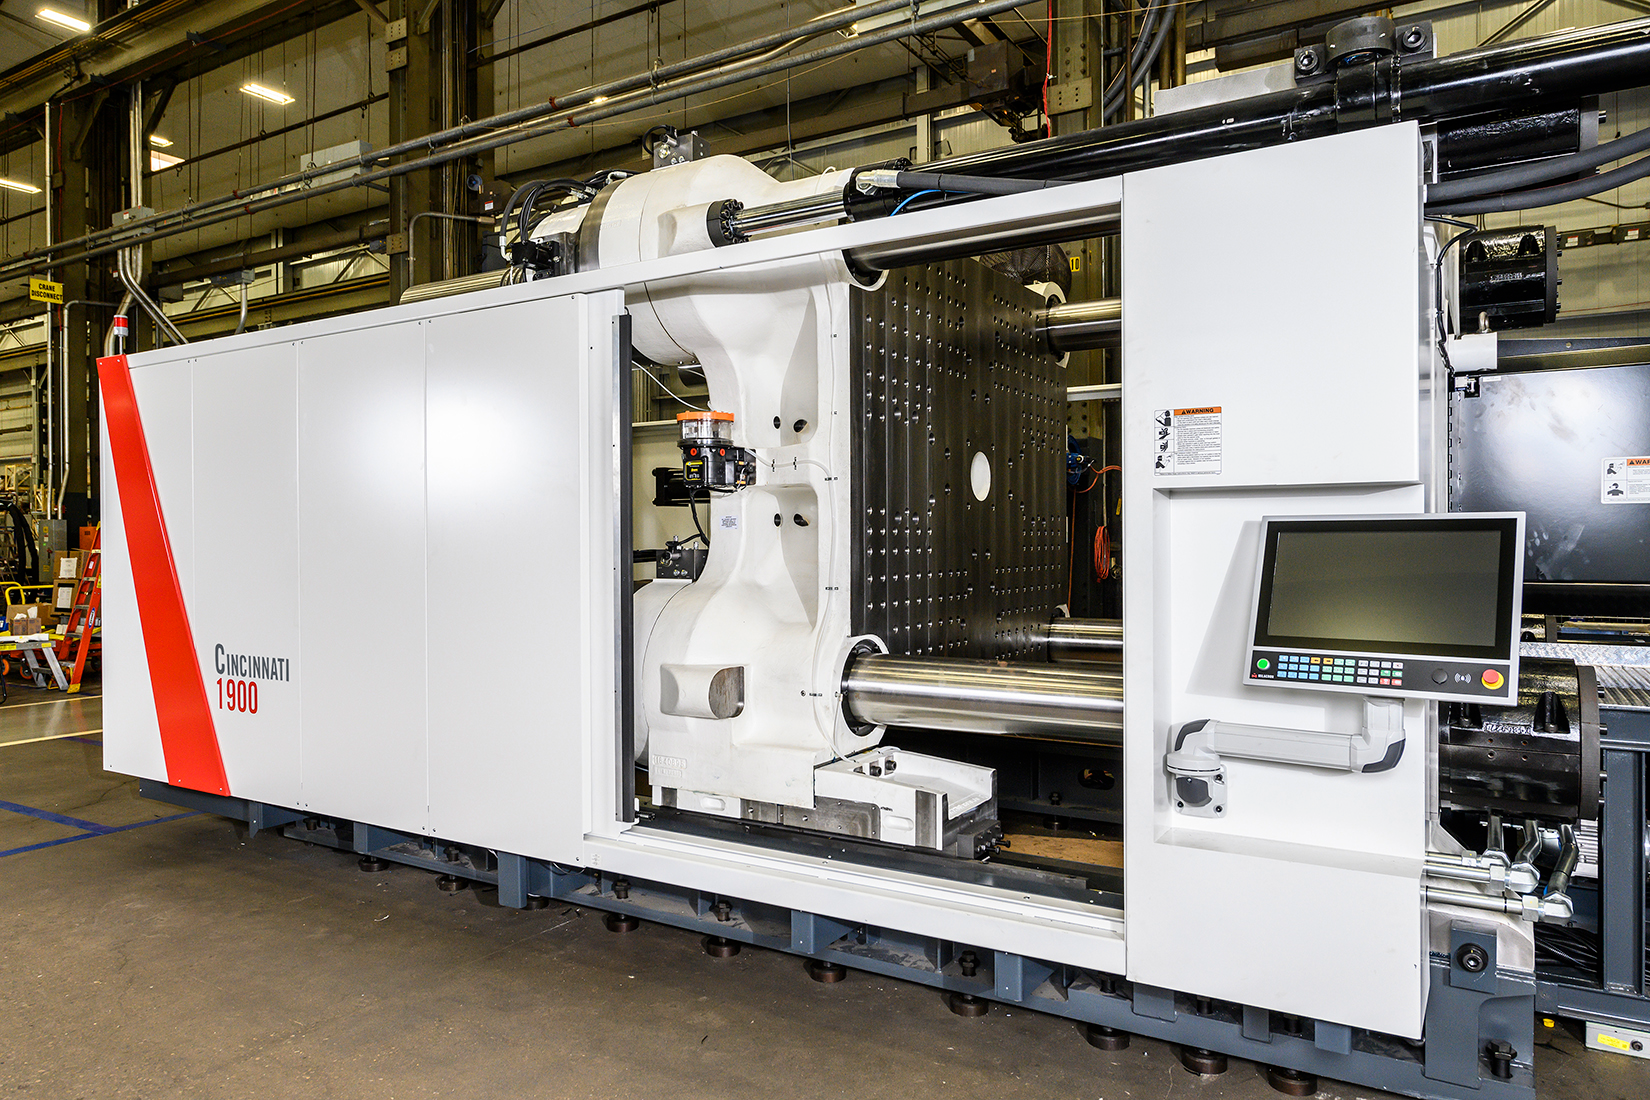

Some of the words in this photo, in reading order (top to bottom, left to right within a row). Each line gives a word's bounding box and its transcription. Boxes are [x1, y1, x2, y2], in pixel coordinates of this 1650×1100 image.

[1071, 257, 1080, 270] 10
[38, 283, 56, 292] CRANE
[31, 289, 63, 301] DISCONNECT
[215, 643, 290, 682] CINCINNATI
[216, 677, 258, 715] 1900
